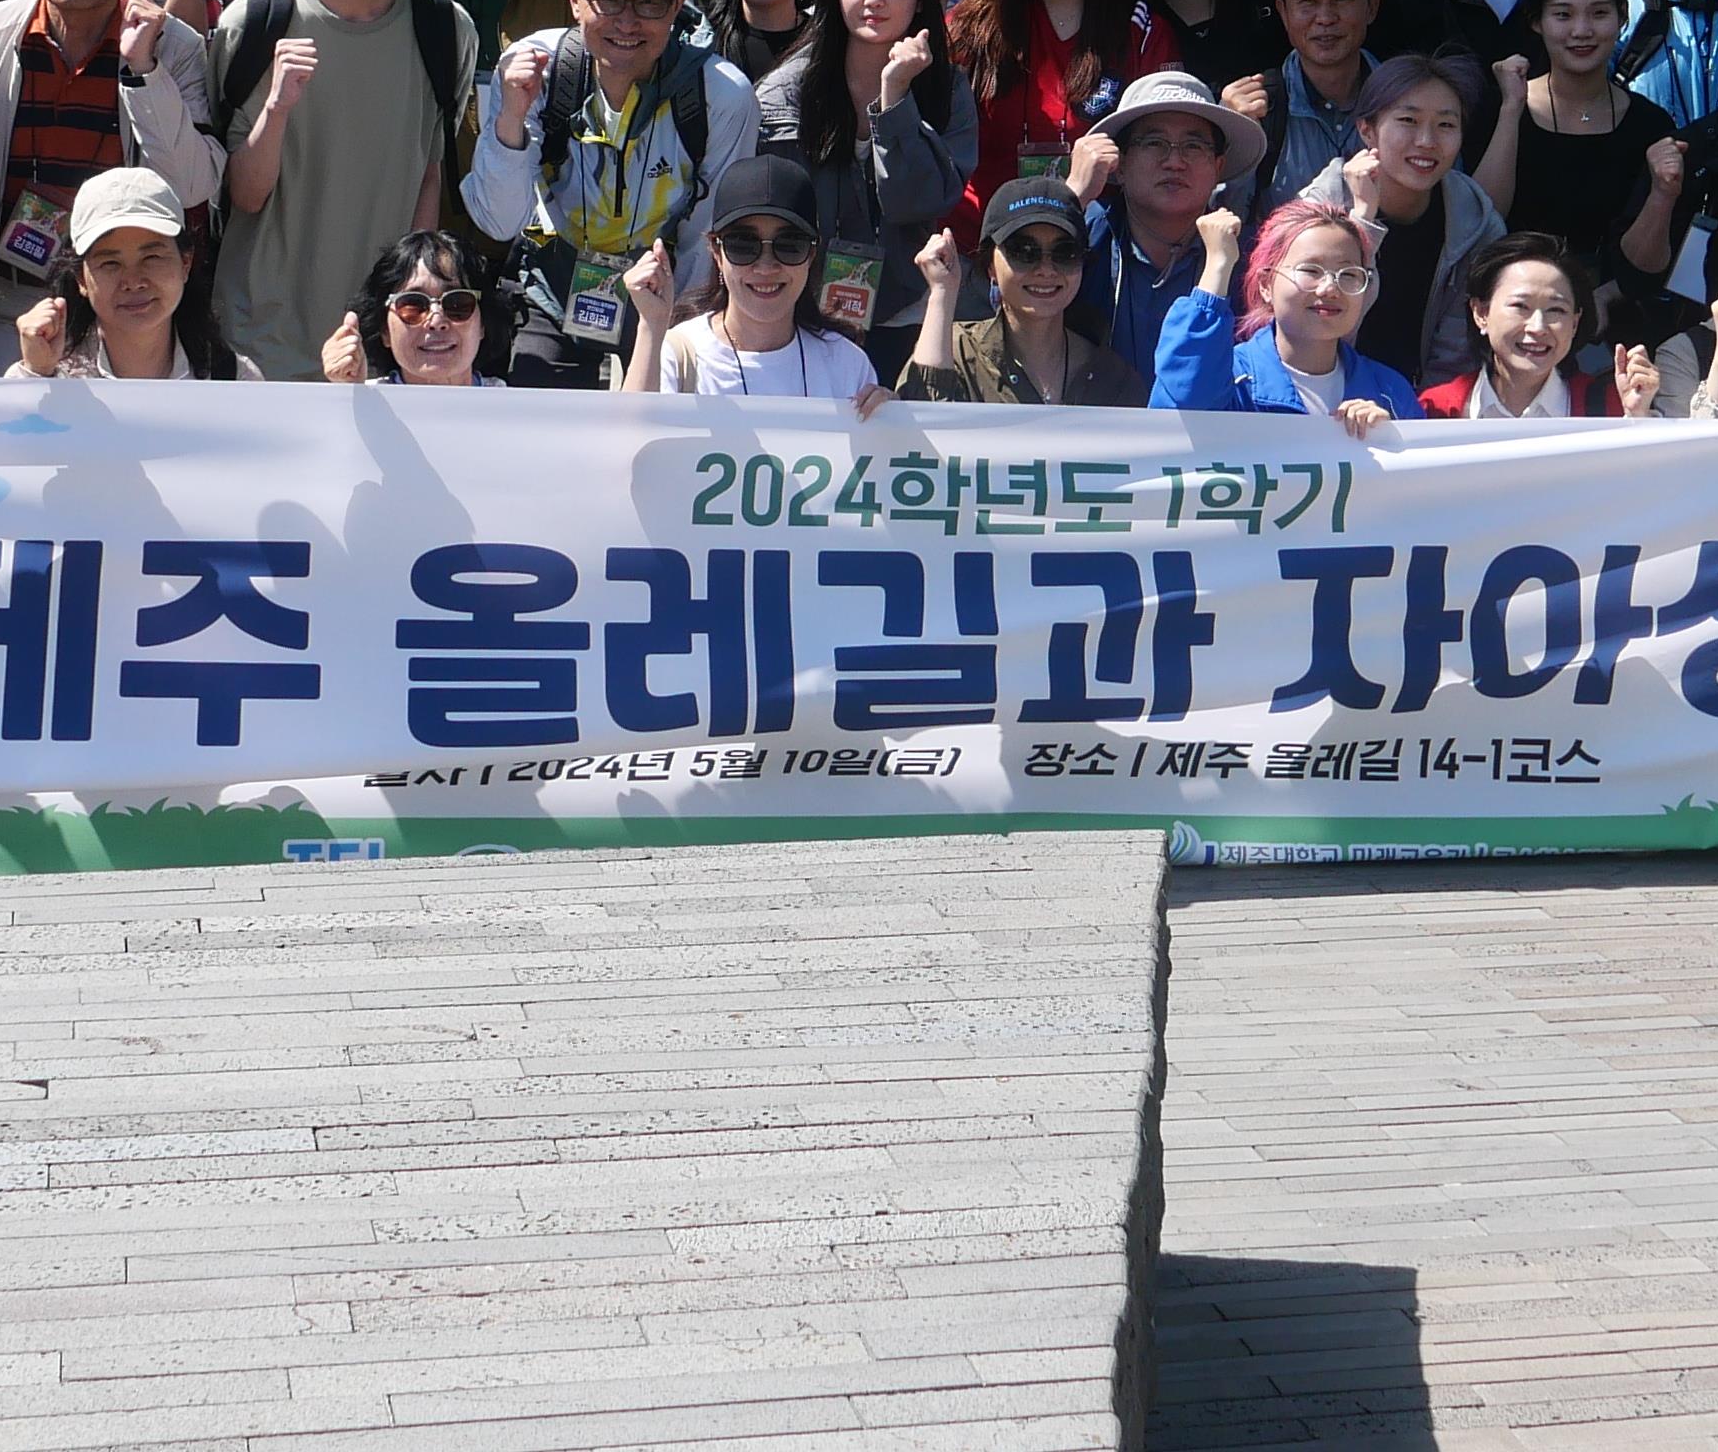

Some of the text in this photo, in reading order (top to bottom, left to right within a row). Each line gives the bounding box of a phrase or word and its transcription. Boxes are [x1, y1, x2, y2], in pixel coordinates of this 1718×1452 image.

[1008, 196, 1067, 212] BALENCIAGA
[692, 451, 1352, 535] 2024학년도 1학기
[395, 541, 1215, 748] 올레길과
[508, 751, 675, 782] 2024년
[689, 749, 768, 779] 5월
[783, 747, 962, 777] 10일(금)
[1024, 742, 1118, 777] 장소
[1156, 741, 1253, 778] 제주
[1264, 738, 1404, 781] 올레길
[1418, 737, 1602, 783] 14-1코스
